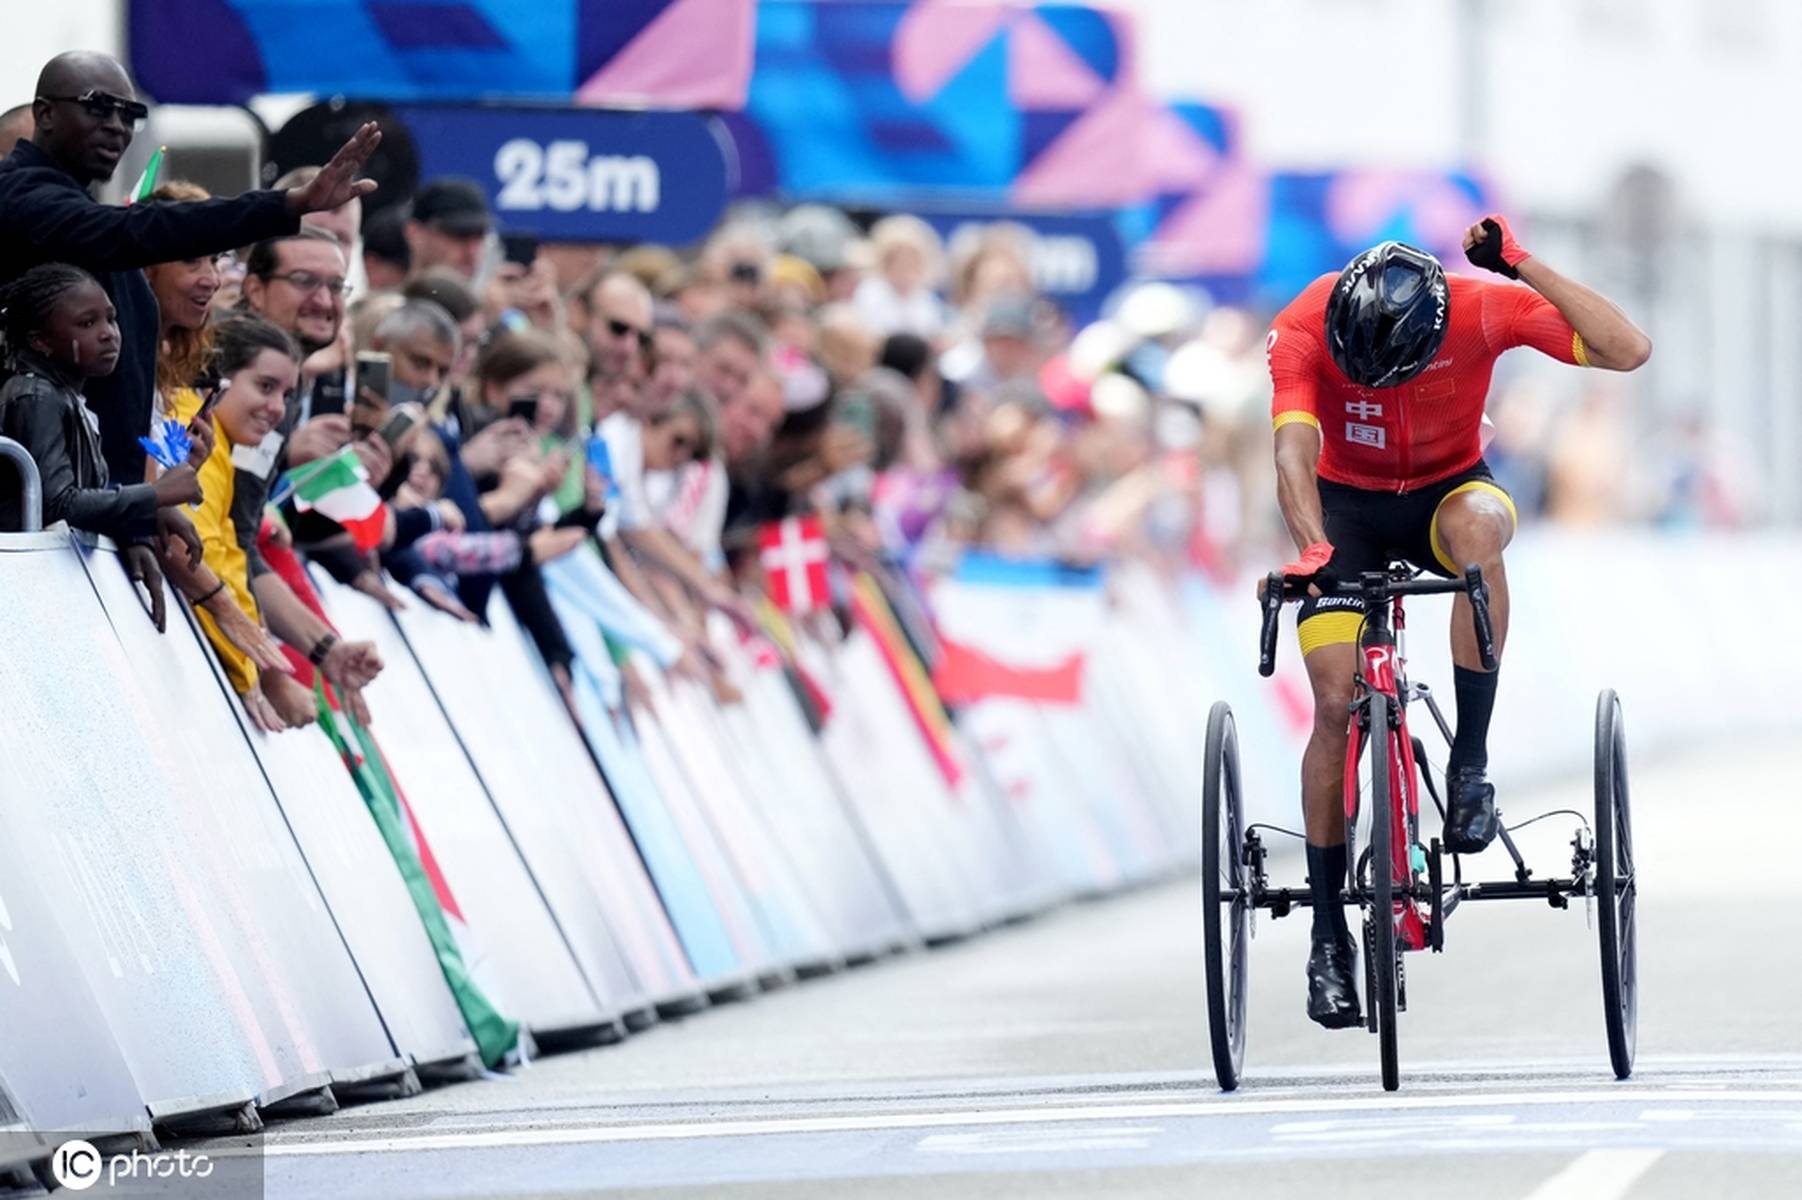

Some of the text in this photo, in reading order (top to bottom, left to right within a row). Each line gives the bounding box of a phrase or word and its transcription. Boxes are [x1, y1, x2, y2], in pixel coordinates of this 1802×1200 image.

[494, 138, 660, 212] 25m
[1433, 283, 1446, 330] KASK
[1345, 400, 1386, 449] 中国
[1316, 596, 1365, 609] Santin
